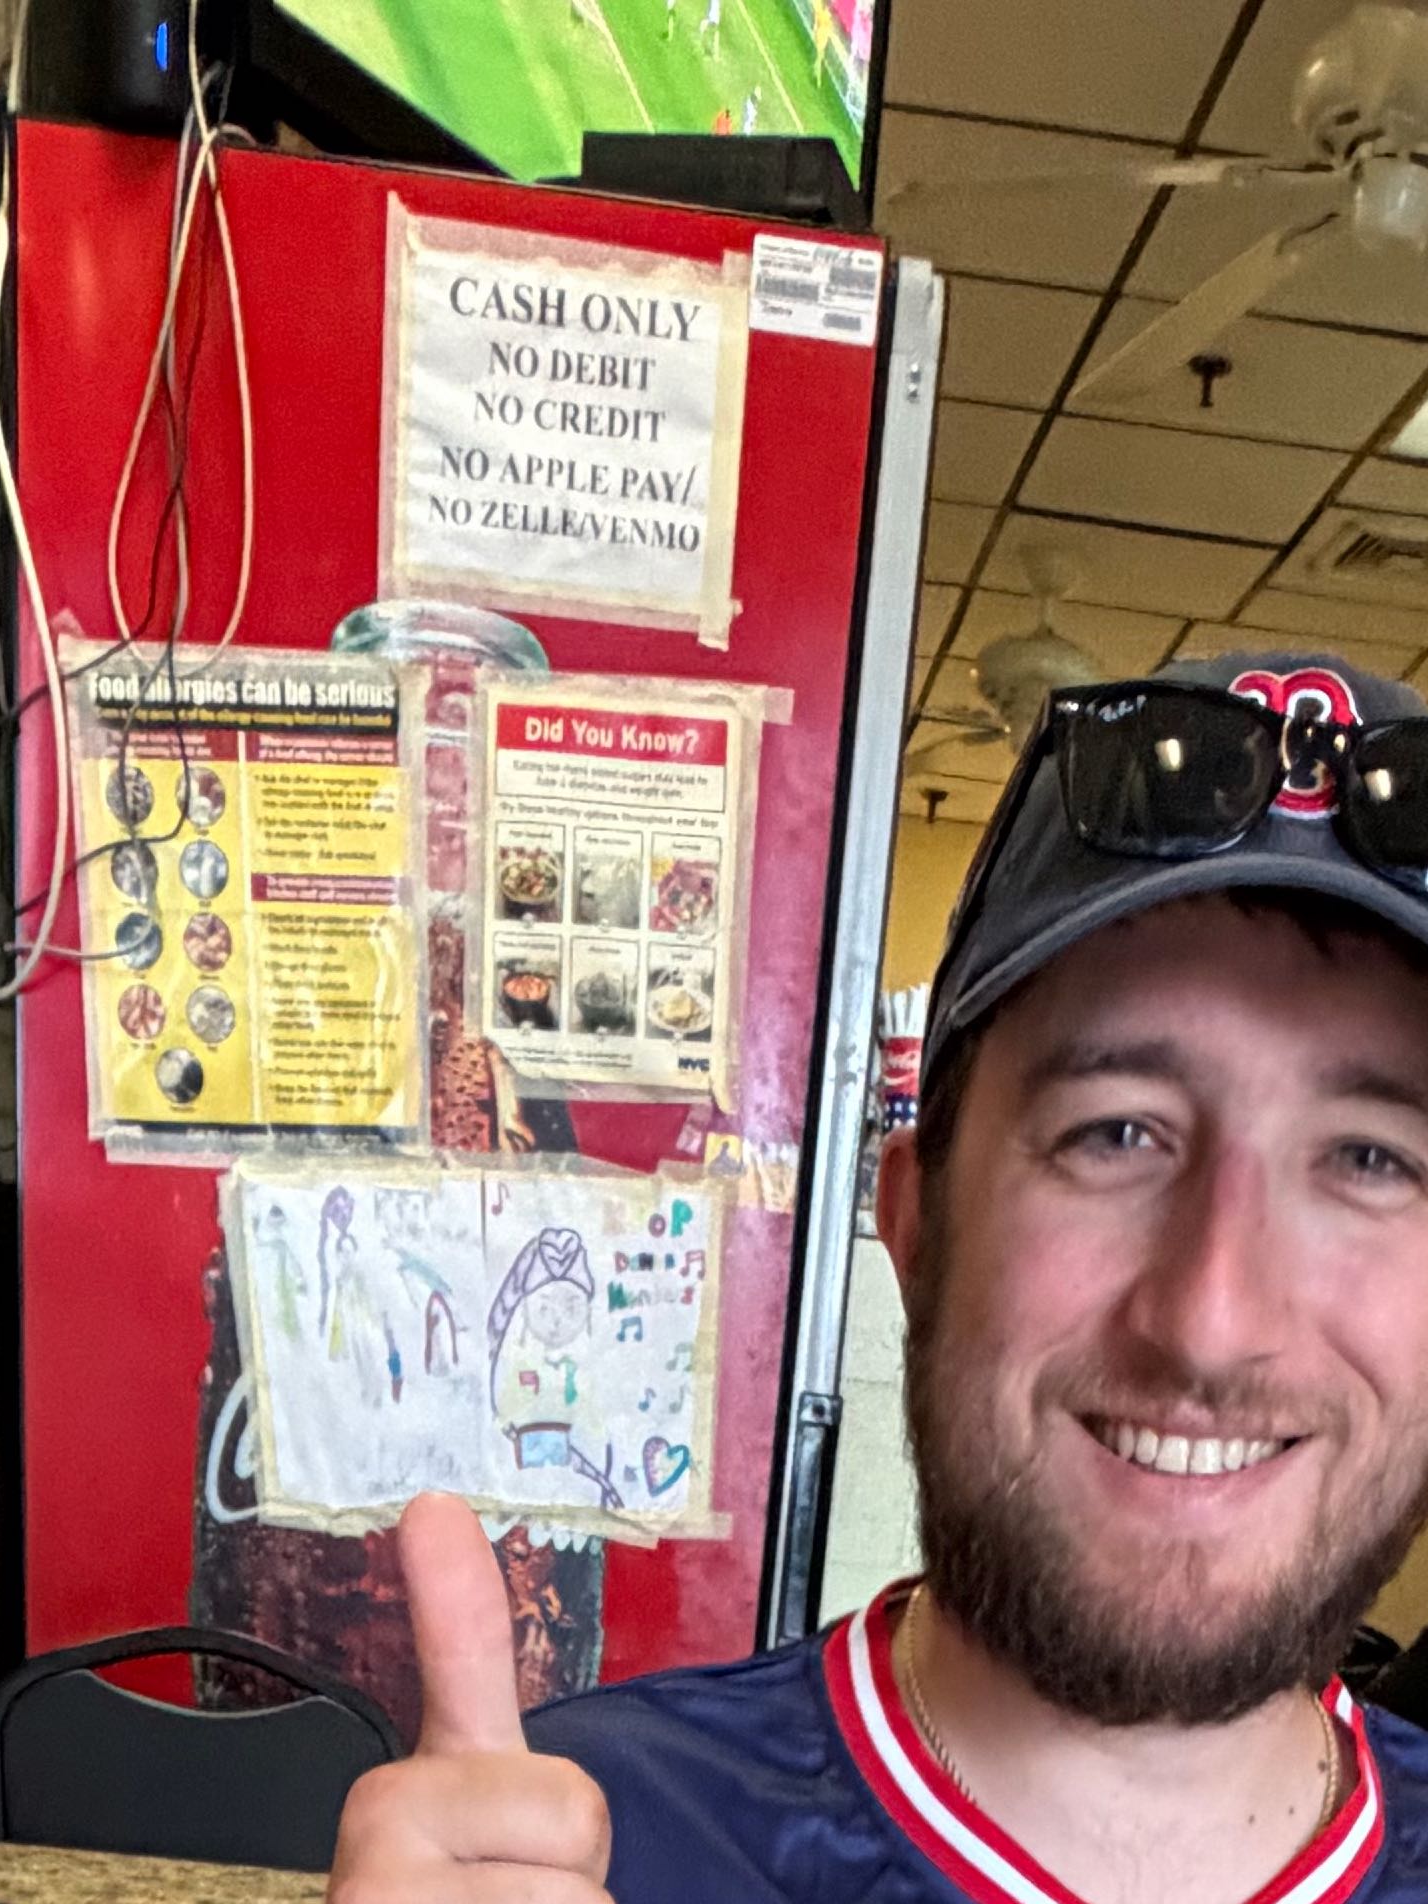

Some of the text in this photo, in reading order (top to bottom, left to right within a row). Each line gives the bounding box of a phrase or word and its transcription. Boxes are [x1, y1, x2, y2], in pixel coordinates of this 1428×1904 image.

[450, 276, 700, 341] CASH ONLY
[489, 341, 656, 390] NO DEBIT
[473, 390, 666, 442] NO CREDIT
[440, 446, 697, 505] NO APPLE PAY/
[429, 493, 700, 552] NO ZELLE/VENMO
[89, 672, 139, 700] Food
[242, 680, 281, 705] can
[285, 679, 311, 706] be
[315, 680, 395, 707] serious
[525, 716, 700, 755] Did You Know?
